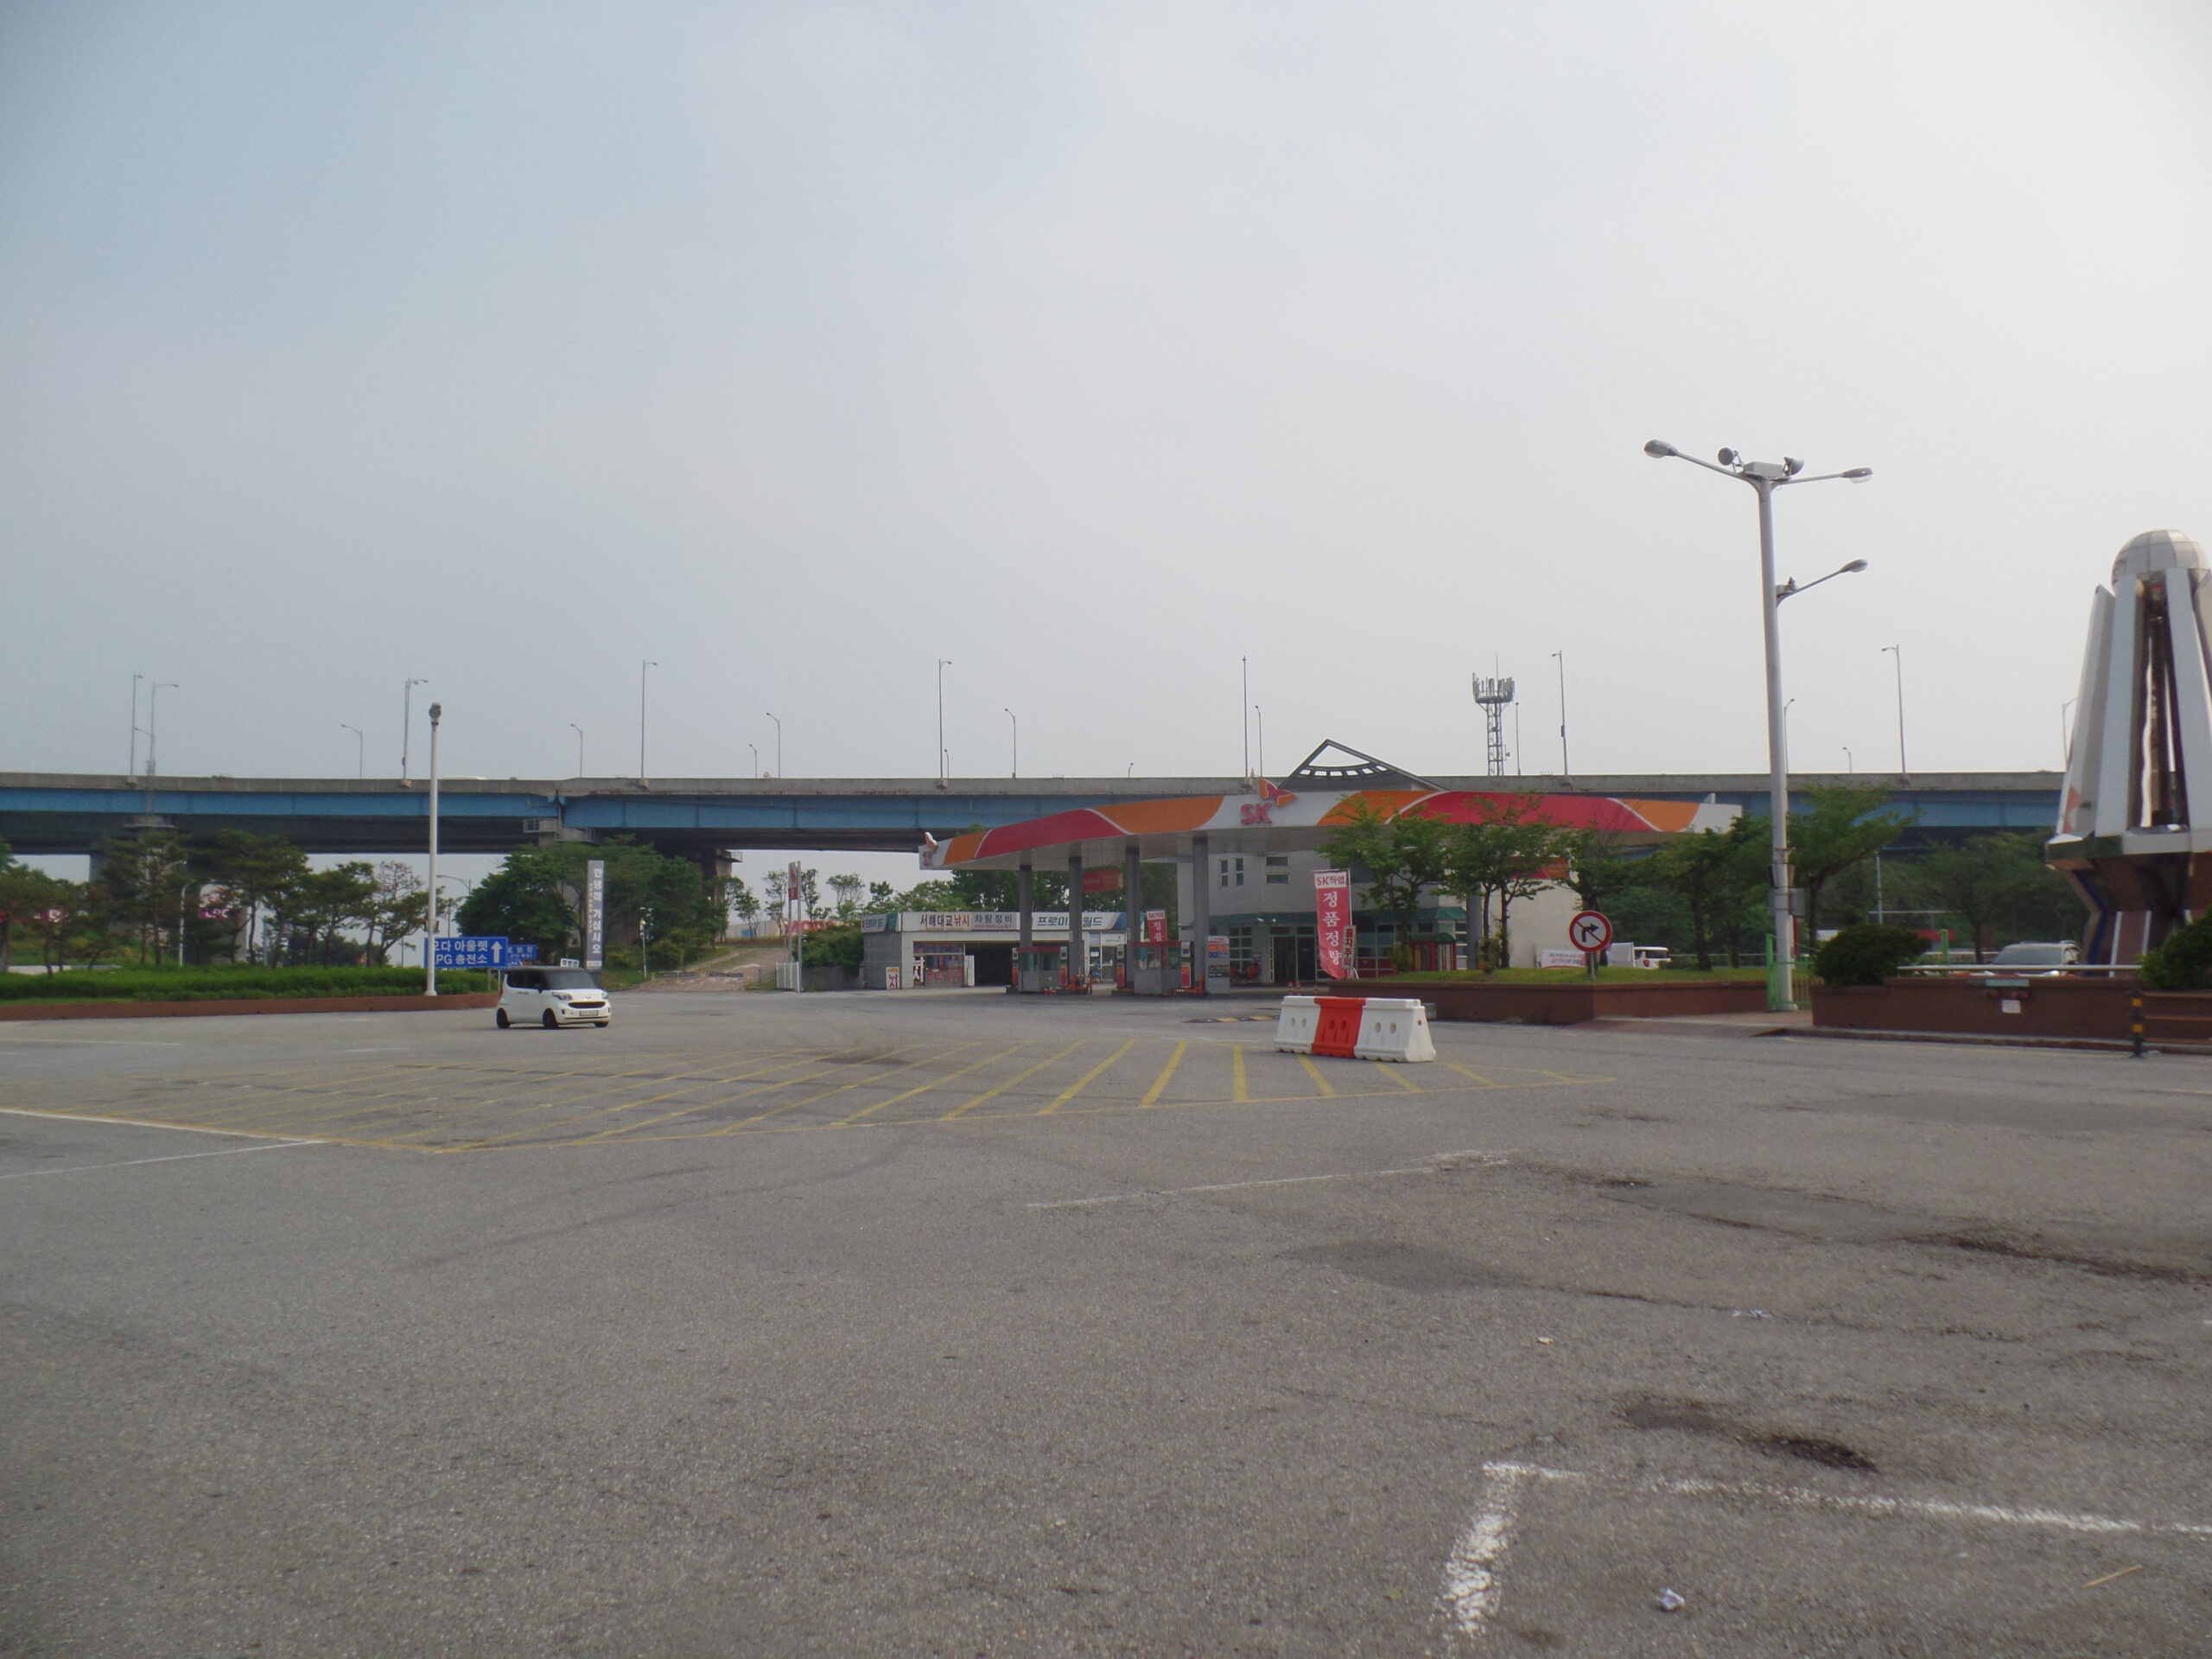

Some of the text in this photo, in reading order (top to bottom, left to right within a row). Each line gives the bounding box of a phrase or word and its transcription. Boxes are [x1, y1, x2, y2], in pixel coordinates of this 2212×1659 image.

[1241, 803, 1272, 824] SK
[454, 940, 488, 952] 아울렛
[435, 954, 488, 965] PG 충전소
